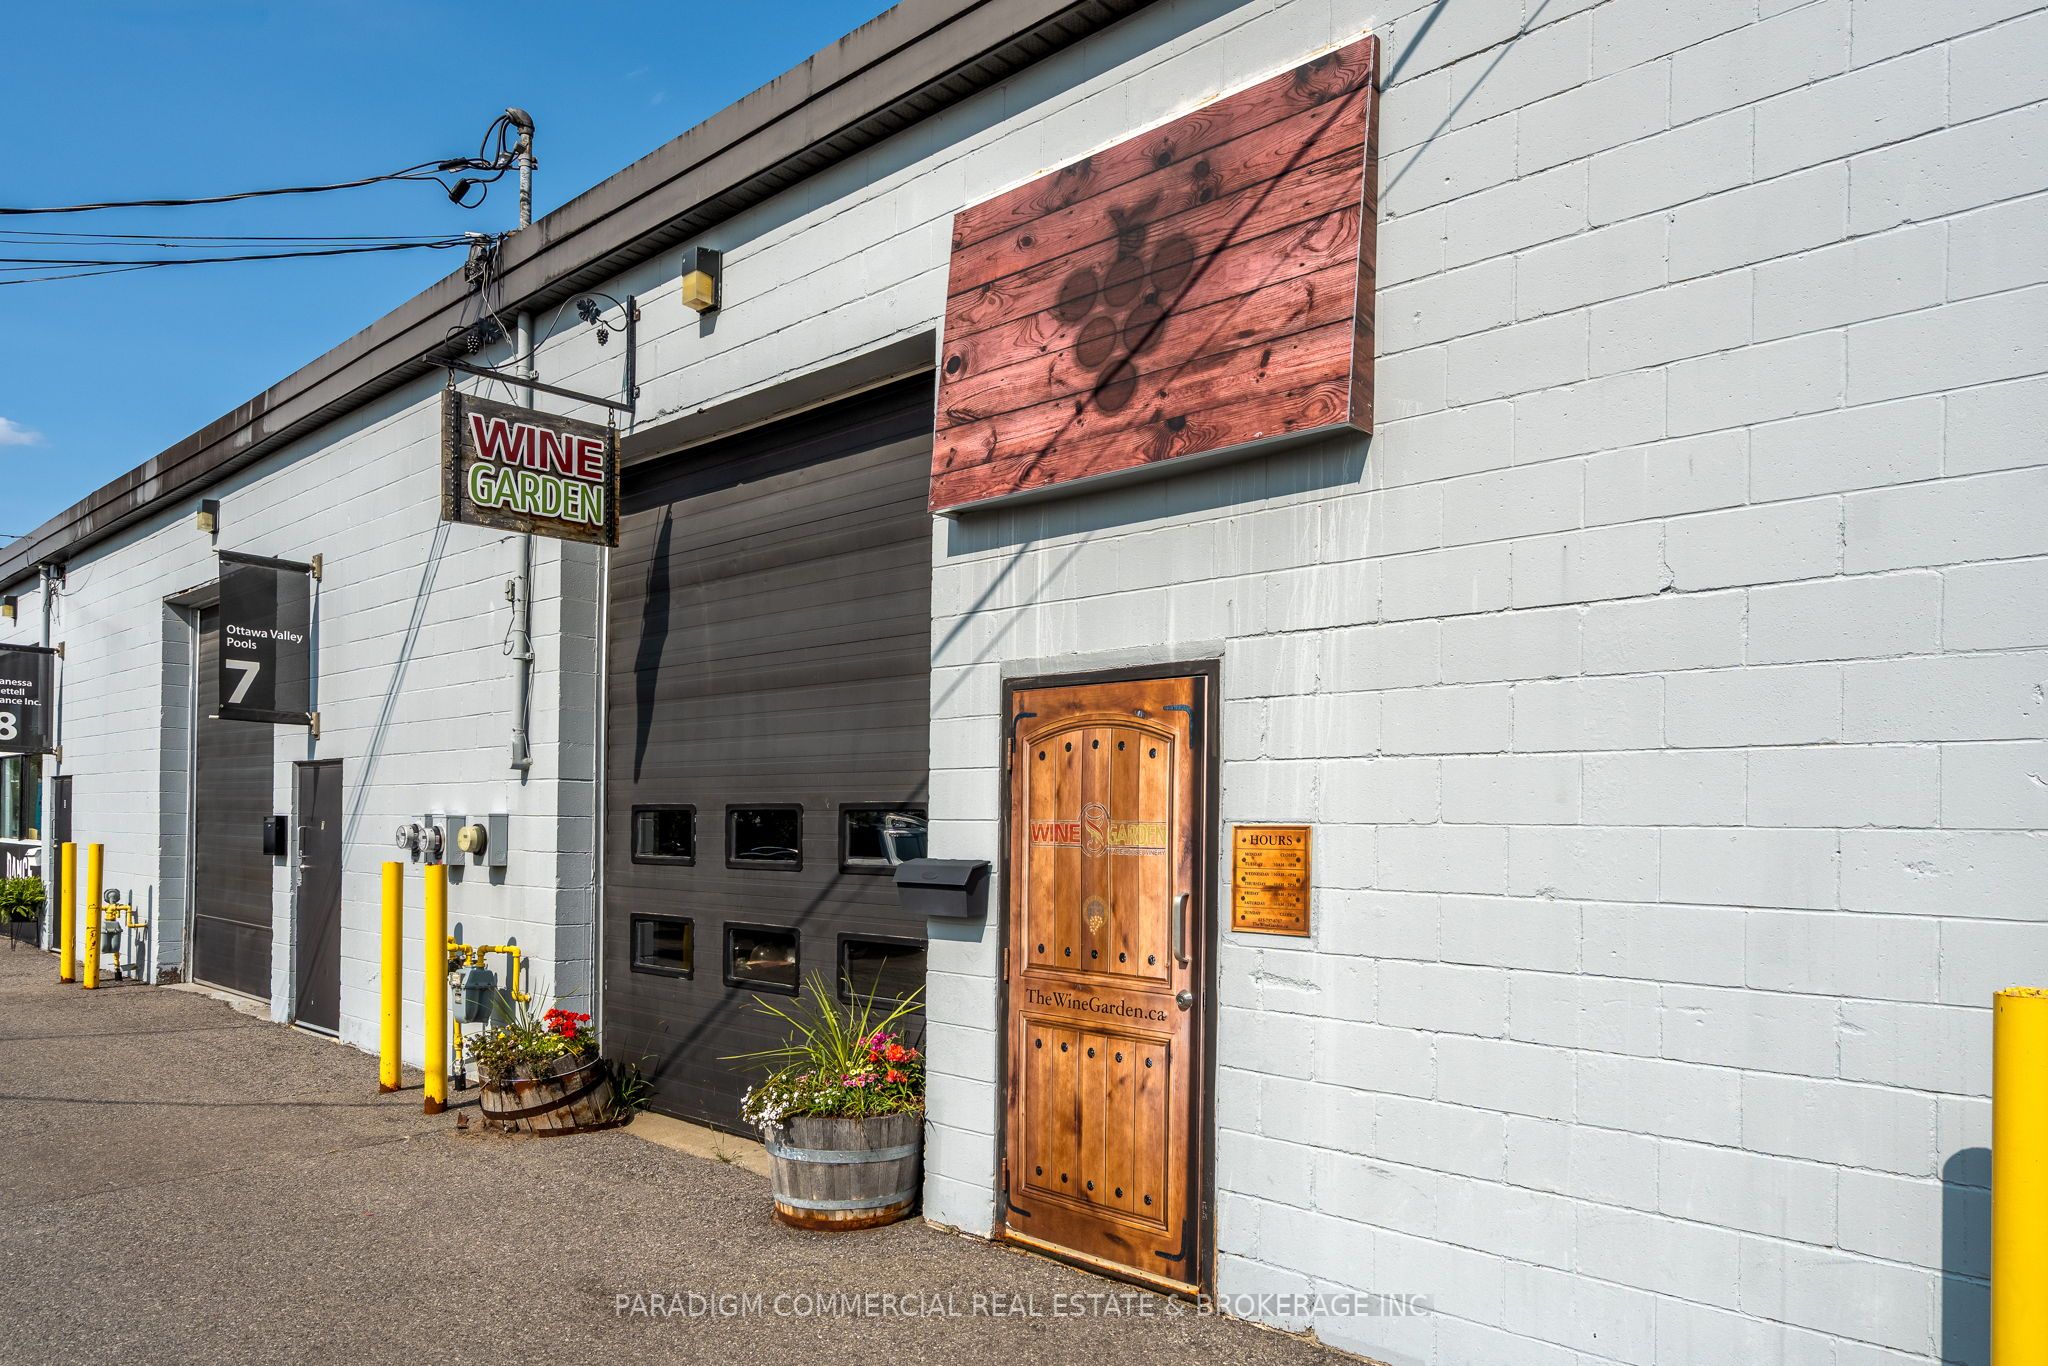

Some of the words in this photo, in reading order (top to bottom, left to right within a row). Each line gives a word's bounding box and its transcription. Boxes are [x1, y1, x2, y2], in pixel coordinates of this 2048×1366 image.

[468, 412, 604, 482] WINE
[468, 462, 604, 526] GARDEN
[226, 624, 268, 638] Ottawa
[270, 629, 303, 644] Valley
[226, 637, 257, 650] Pools
[0, 678, 33, 687] anessa
[225, 658, 260, 704] 7
[0, 688, 25, 696] ettell
[0, 697, 23, 705] ance
[24, 697, 42, 706] Inc.
[0, 711, 18, 740] 8
[1031, 822, 1081, 844] WINE
[1108, 822, 1167, 845] GARDEN
[1250, 834, 1293, 846] HOURS
[1025, 988, 1168, 1021] TheWineGarden.ca
